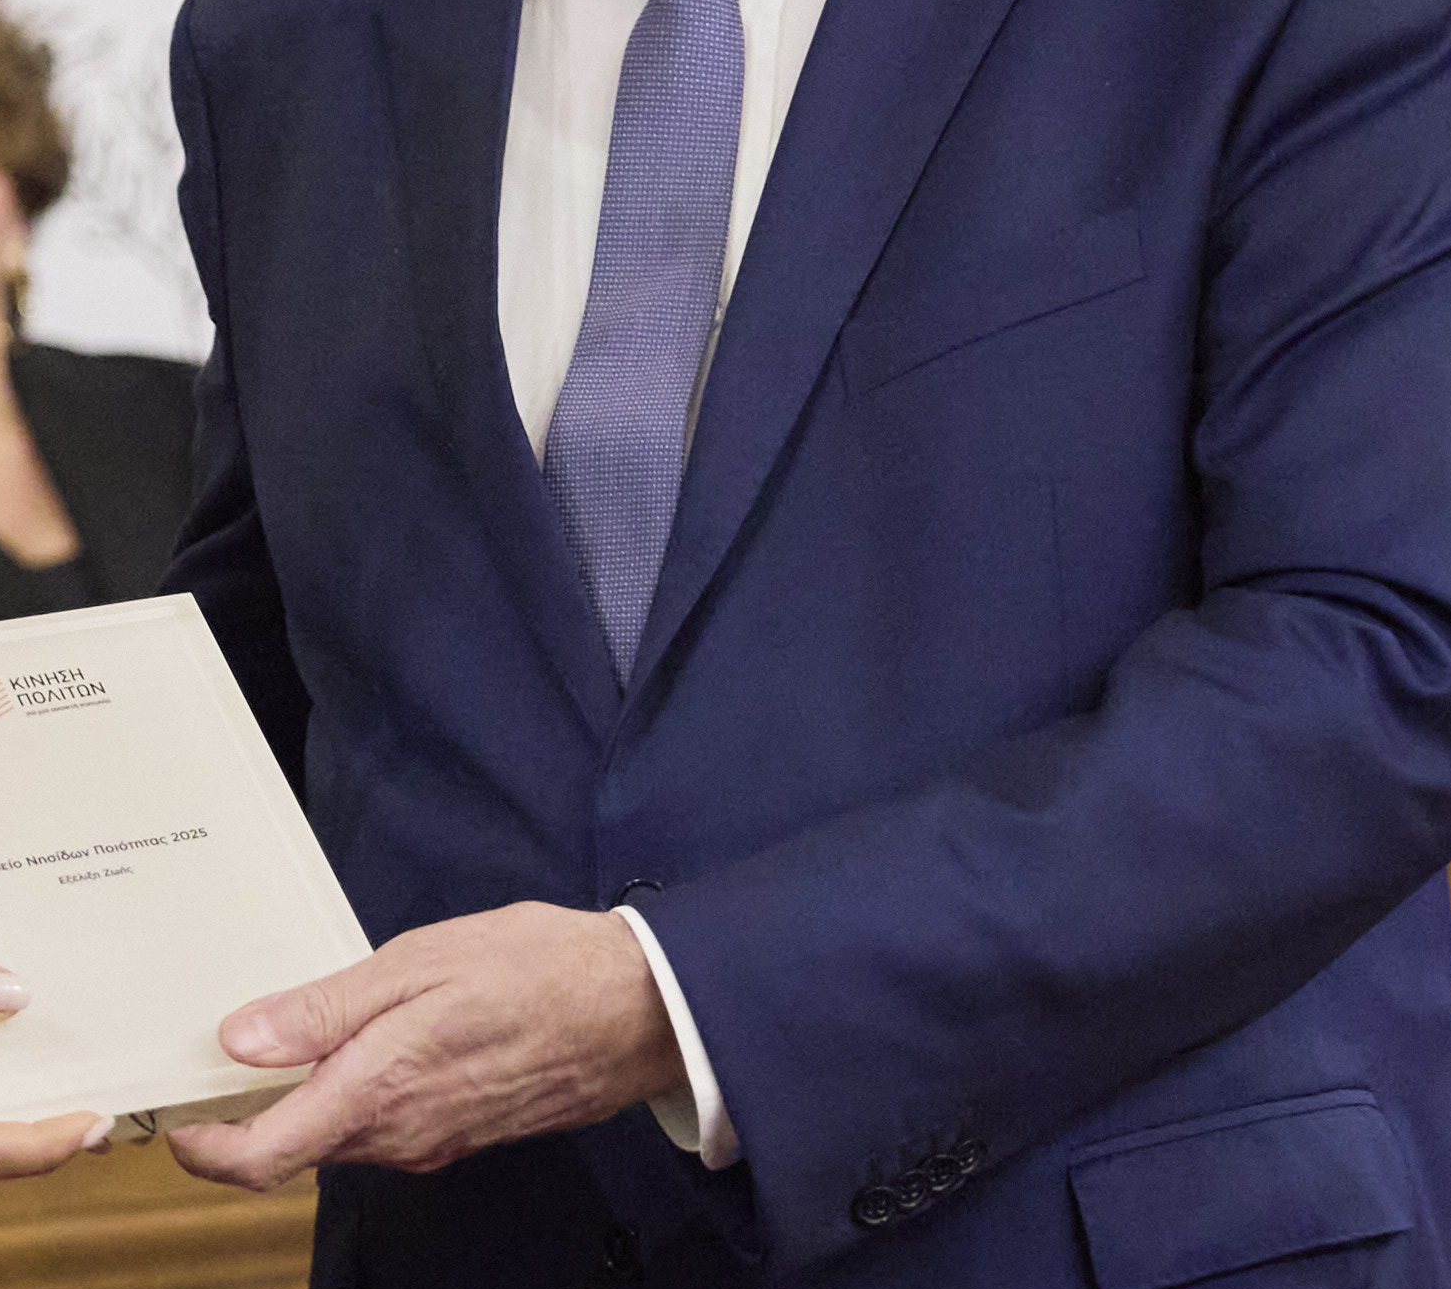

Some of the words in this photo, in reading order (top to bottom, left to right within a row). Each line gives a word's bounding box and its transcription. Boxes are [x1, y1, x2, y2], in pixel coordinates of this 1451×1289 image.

[9, 667, 86, 691] ΚΙΝΗΣΗ
[16, 681, 107, 707] ΠΟΛΙΤΩΝ
[26, 847, 90, 867] Νησίδων
[93, 833, 169, 856] Ποιότητας
[171, 827, 208, 843] 2025
